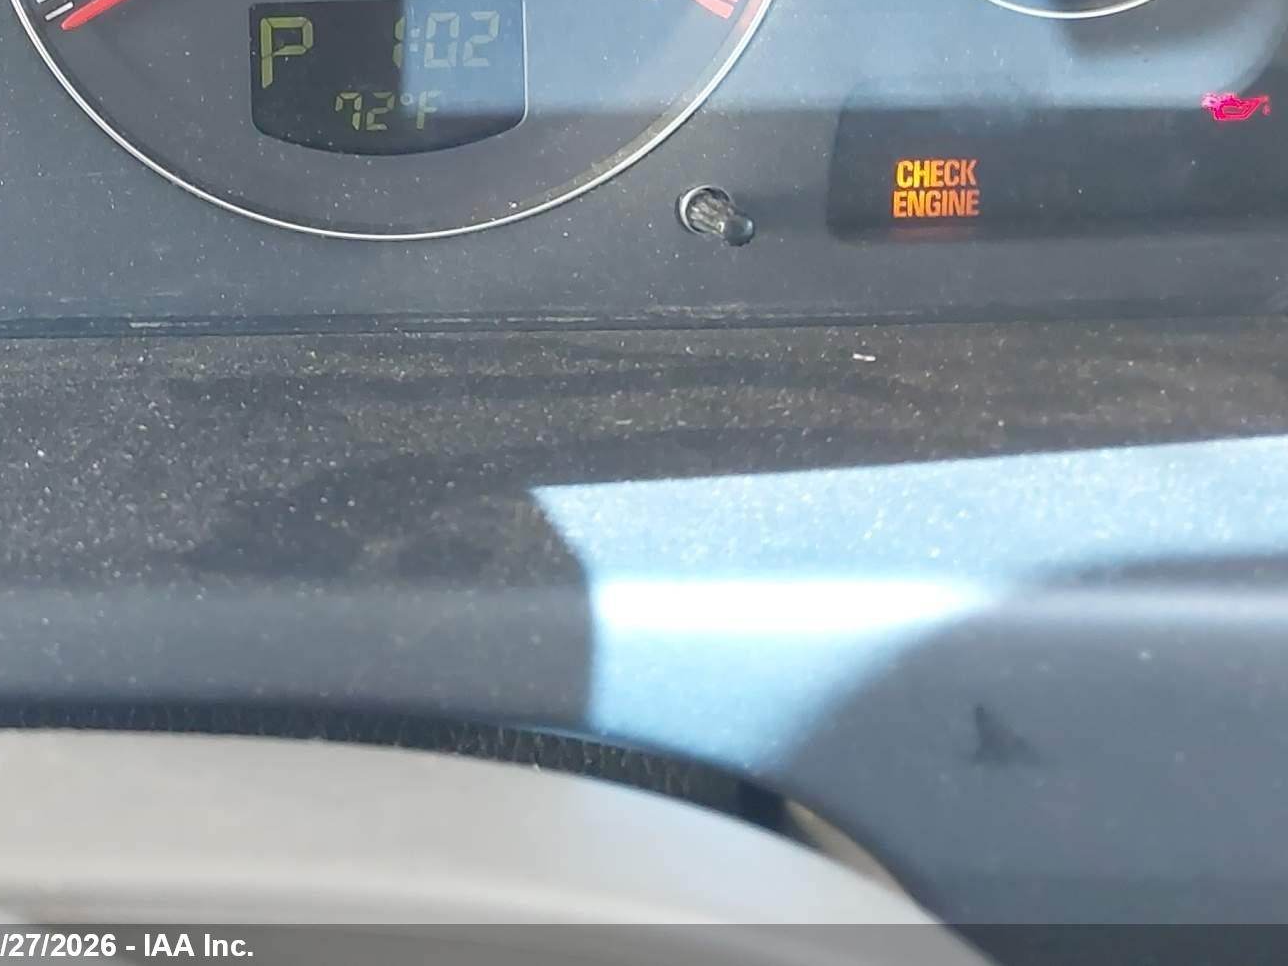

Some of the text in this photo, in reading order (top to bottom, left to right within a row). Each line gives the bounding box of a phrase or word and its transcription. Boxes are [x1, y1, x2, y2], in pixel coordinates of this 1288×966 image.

[260, 10, 500, 88] P 1:02
[896, 159, 977, 188] CHECK
[893, 189, 979, 218] ENGINE
